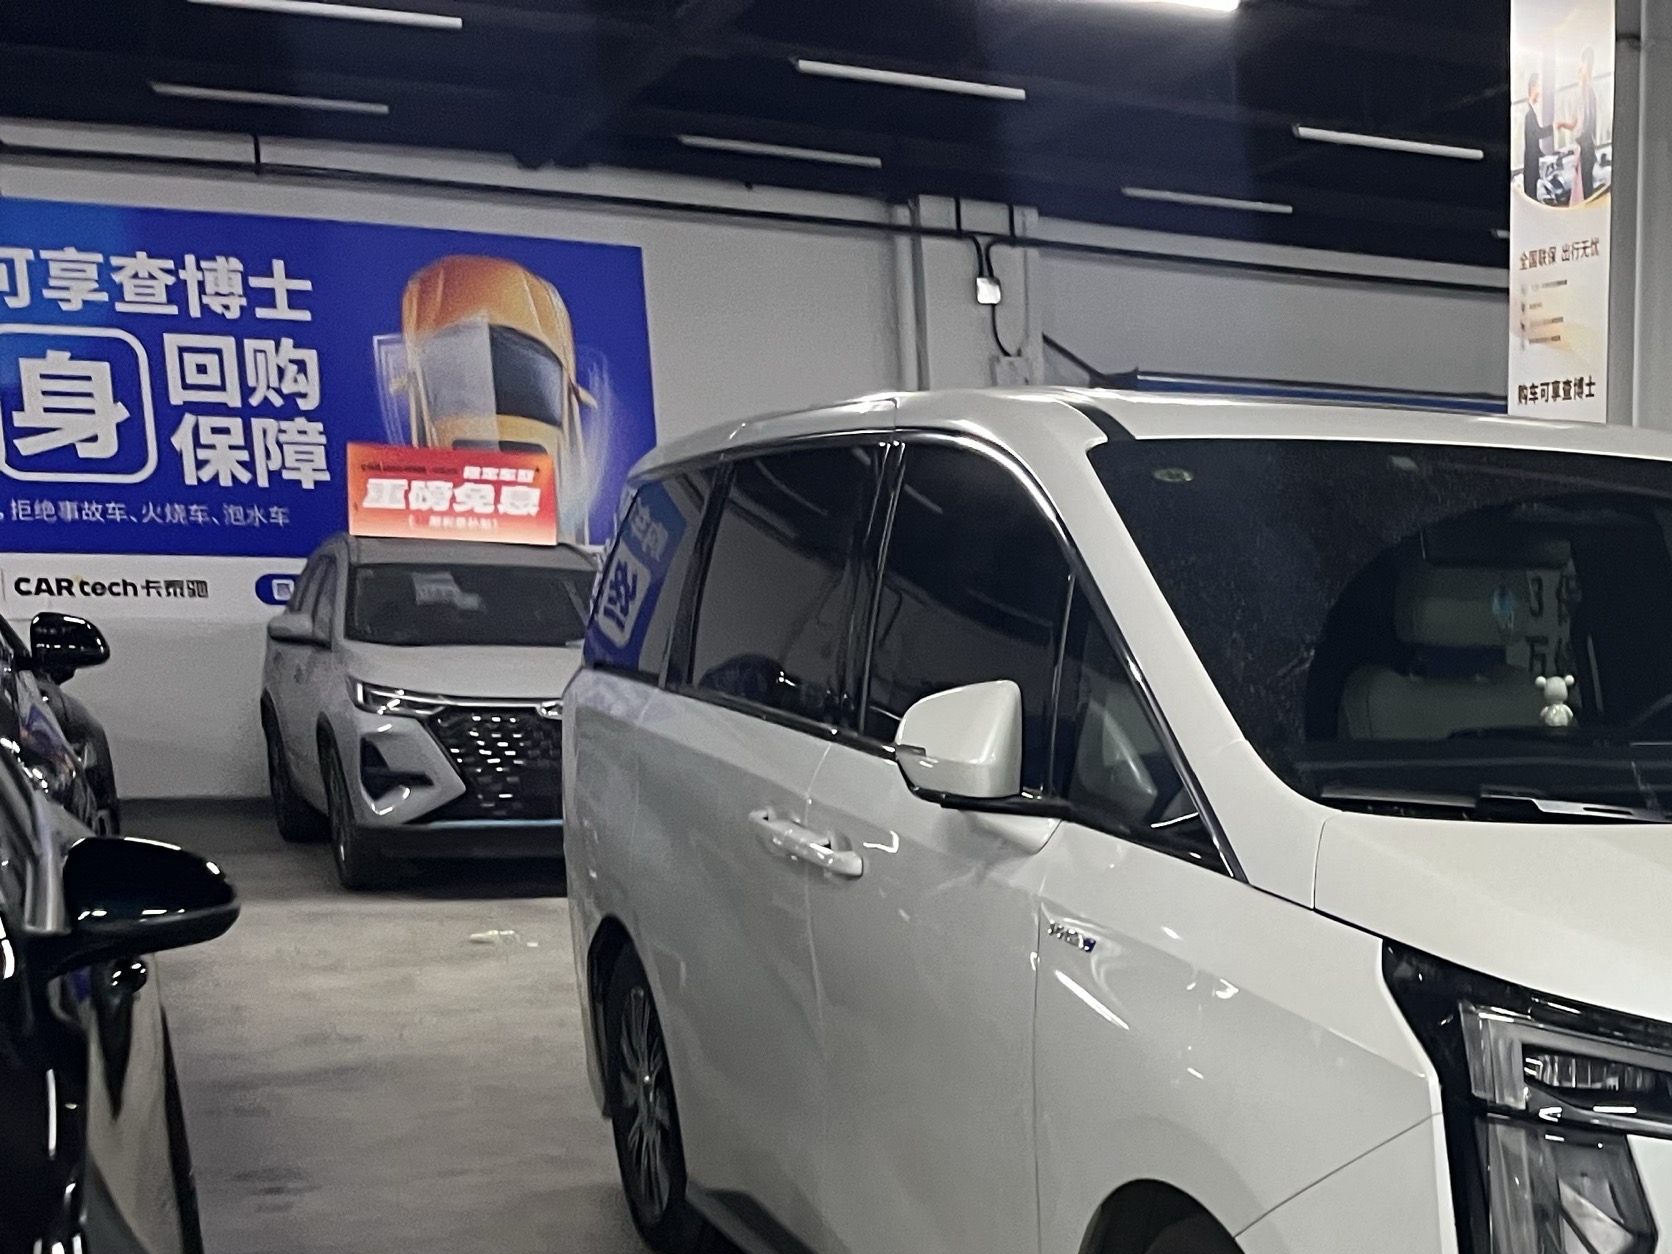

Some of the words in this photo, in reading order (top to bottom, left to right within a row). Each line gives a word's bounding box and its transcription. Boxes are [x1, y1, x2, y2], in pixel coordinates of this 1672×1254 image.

[12, 349, 130, 459] 身
[163, 332, 320, 411] 回购
[1517, 374, 1596, 406] 购车可享查博士
[170, 412, 331, 489] 保障
